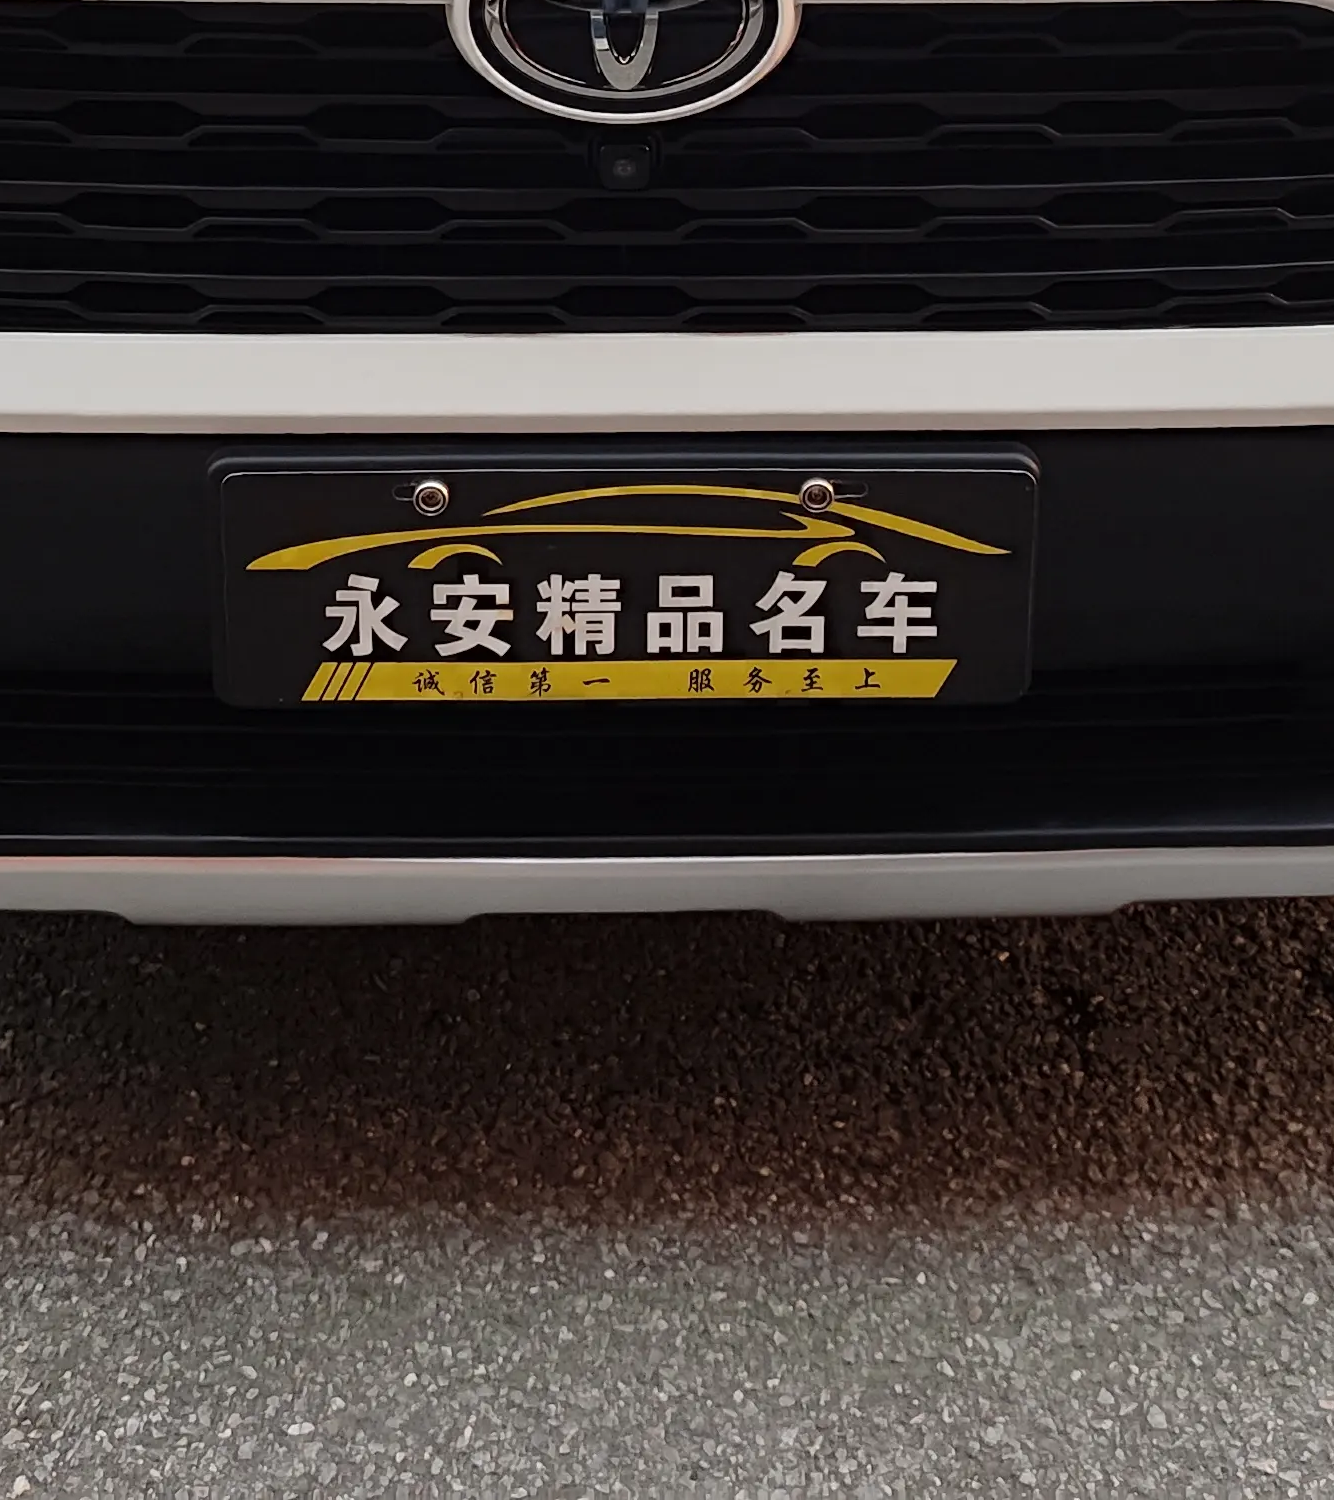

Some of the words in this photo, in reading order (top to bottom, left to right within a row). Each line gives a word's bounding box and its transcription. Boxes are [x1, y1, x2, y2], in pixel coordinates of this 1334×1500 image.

[322, 573, 939, 657] 永安精品名车
[412, 668, 612, 698] 诚信第一
[685, 666, 883, 696] 服务至上
